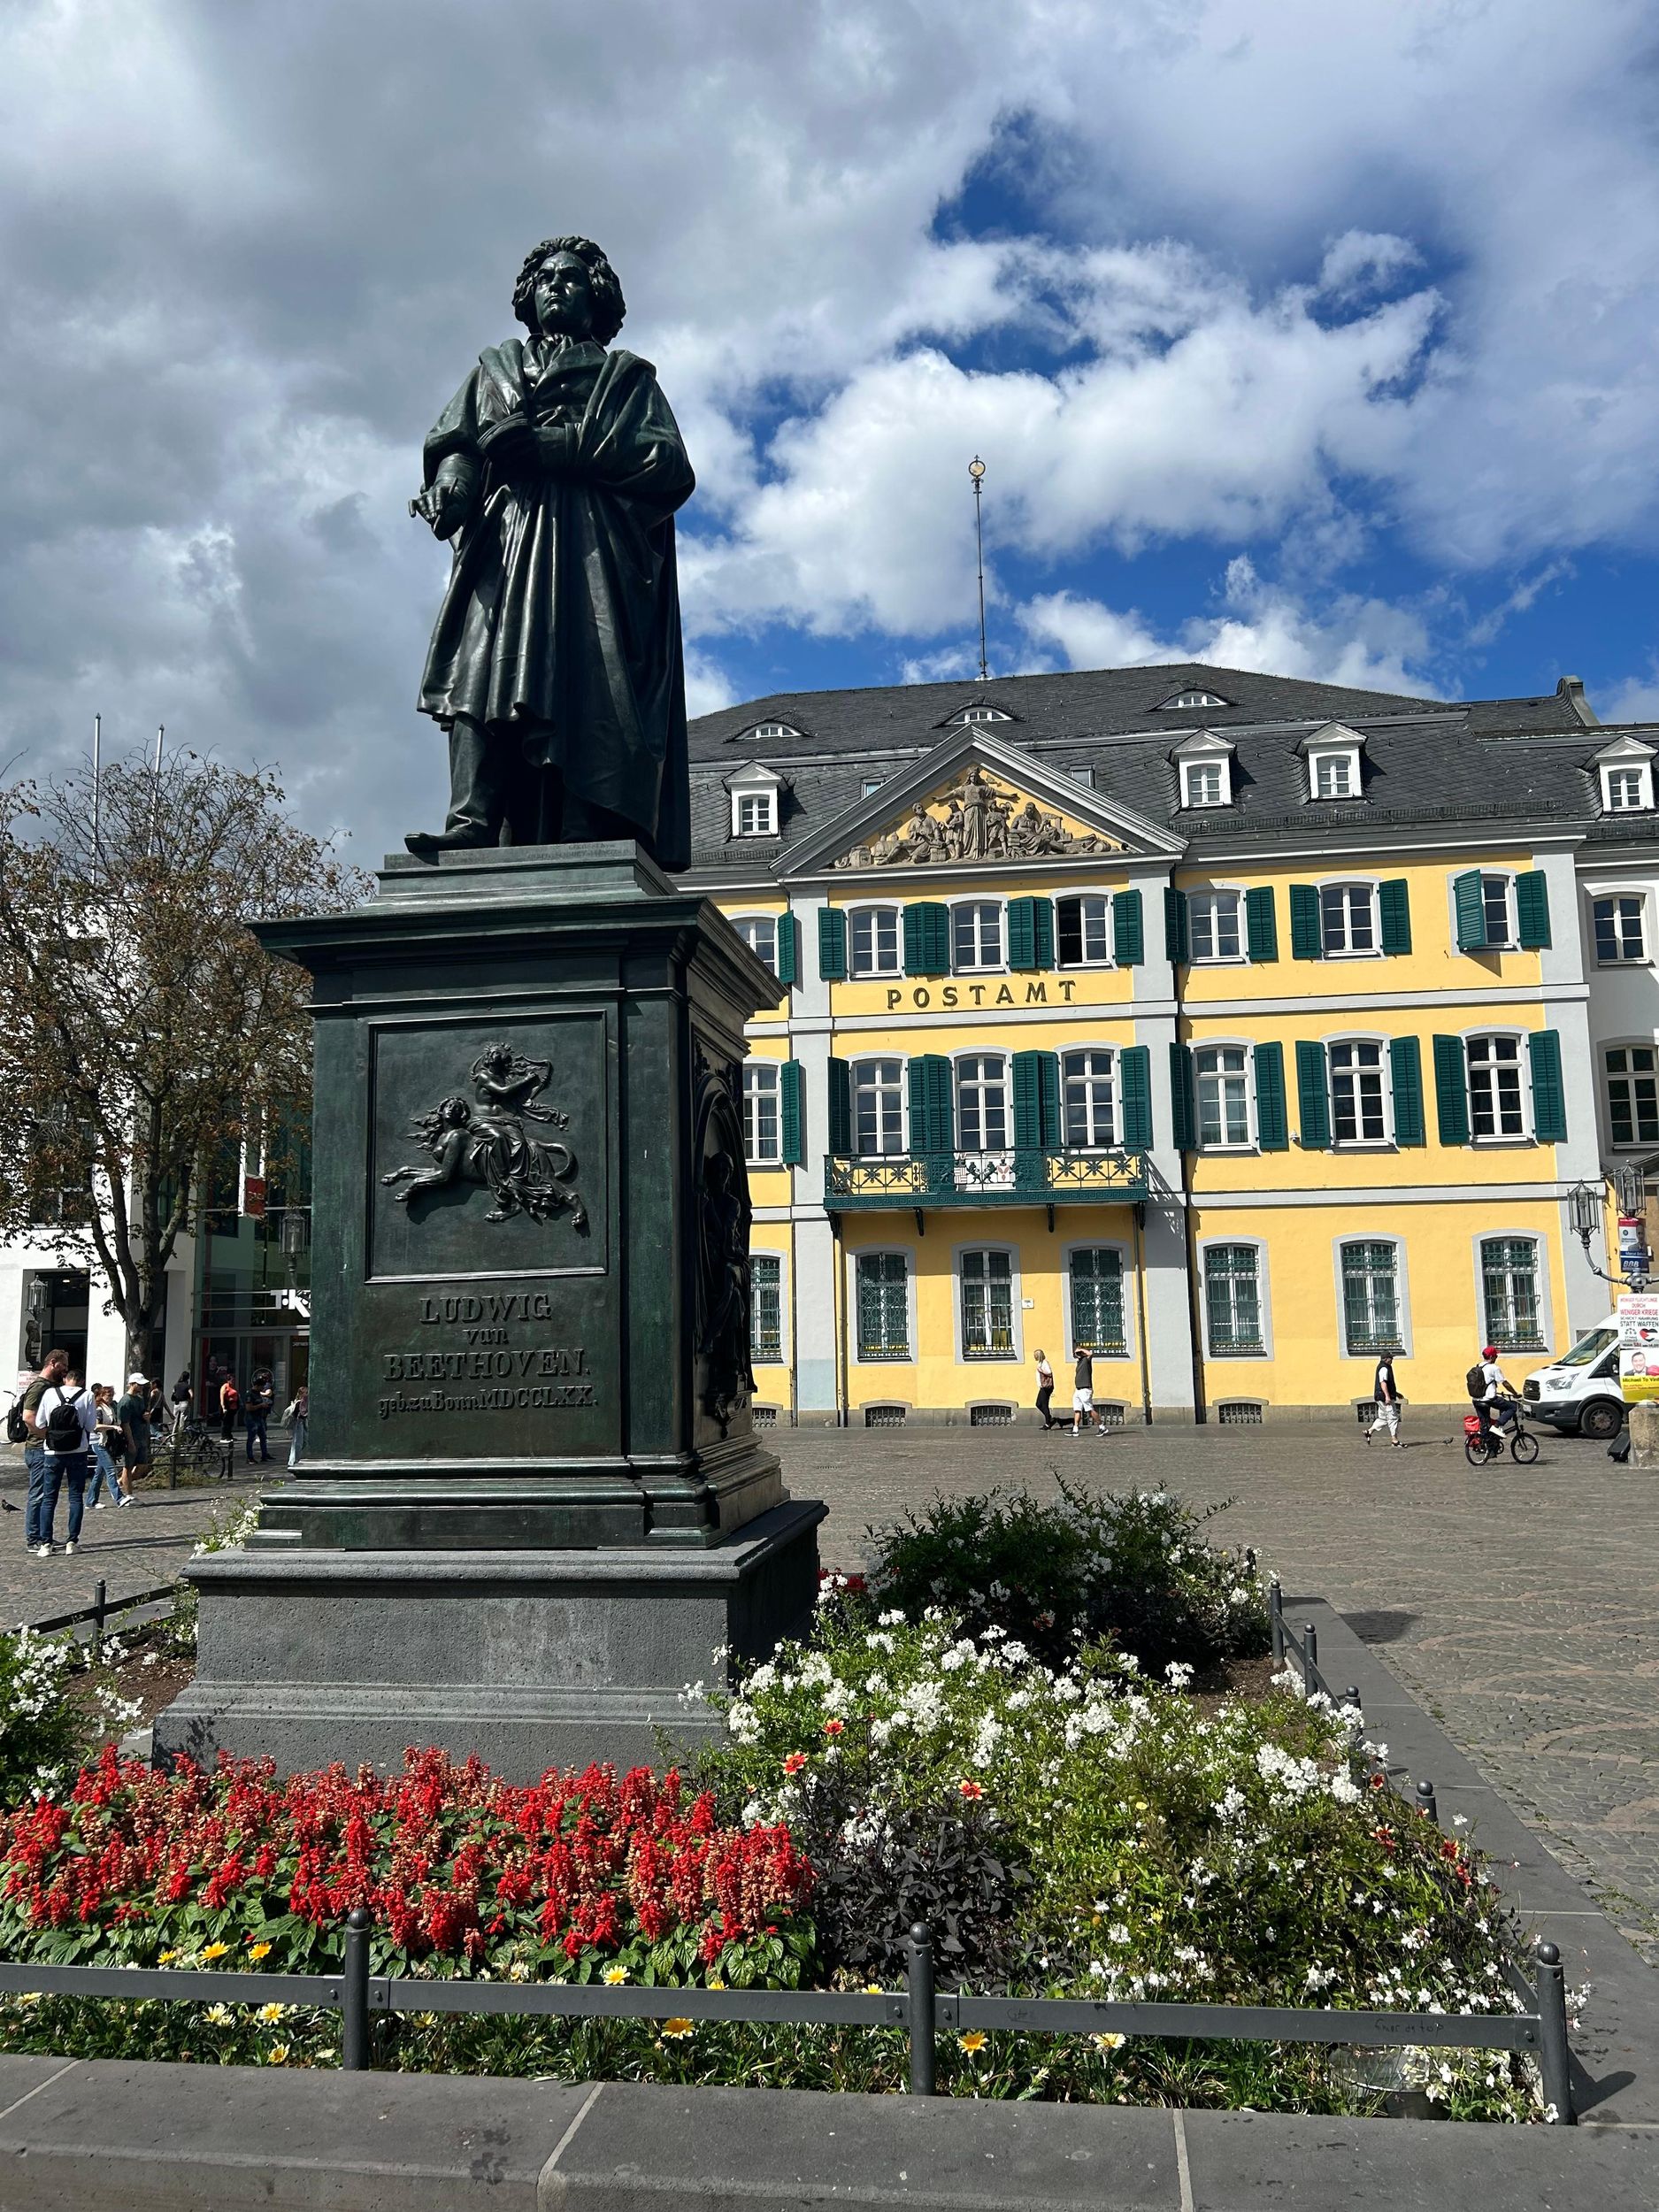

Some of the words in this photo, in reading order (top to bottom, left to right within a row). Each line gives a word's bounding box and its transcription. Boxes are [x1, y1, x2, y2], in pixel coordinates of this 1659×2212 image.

[887, 979, 1076, 1010] POSTAMT
[419, 1294, 552, 1325] LUDWIG
[383, 1348, 591, 1381] BEETHOVEN.
[431, 1390, 479, 1411] Bonn
[479, 1386, 598, 1410] MDCCLXX.
